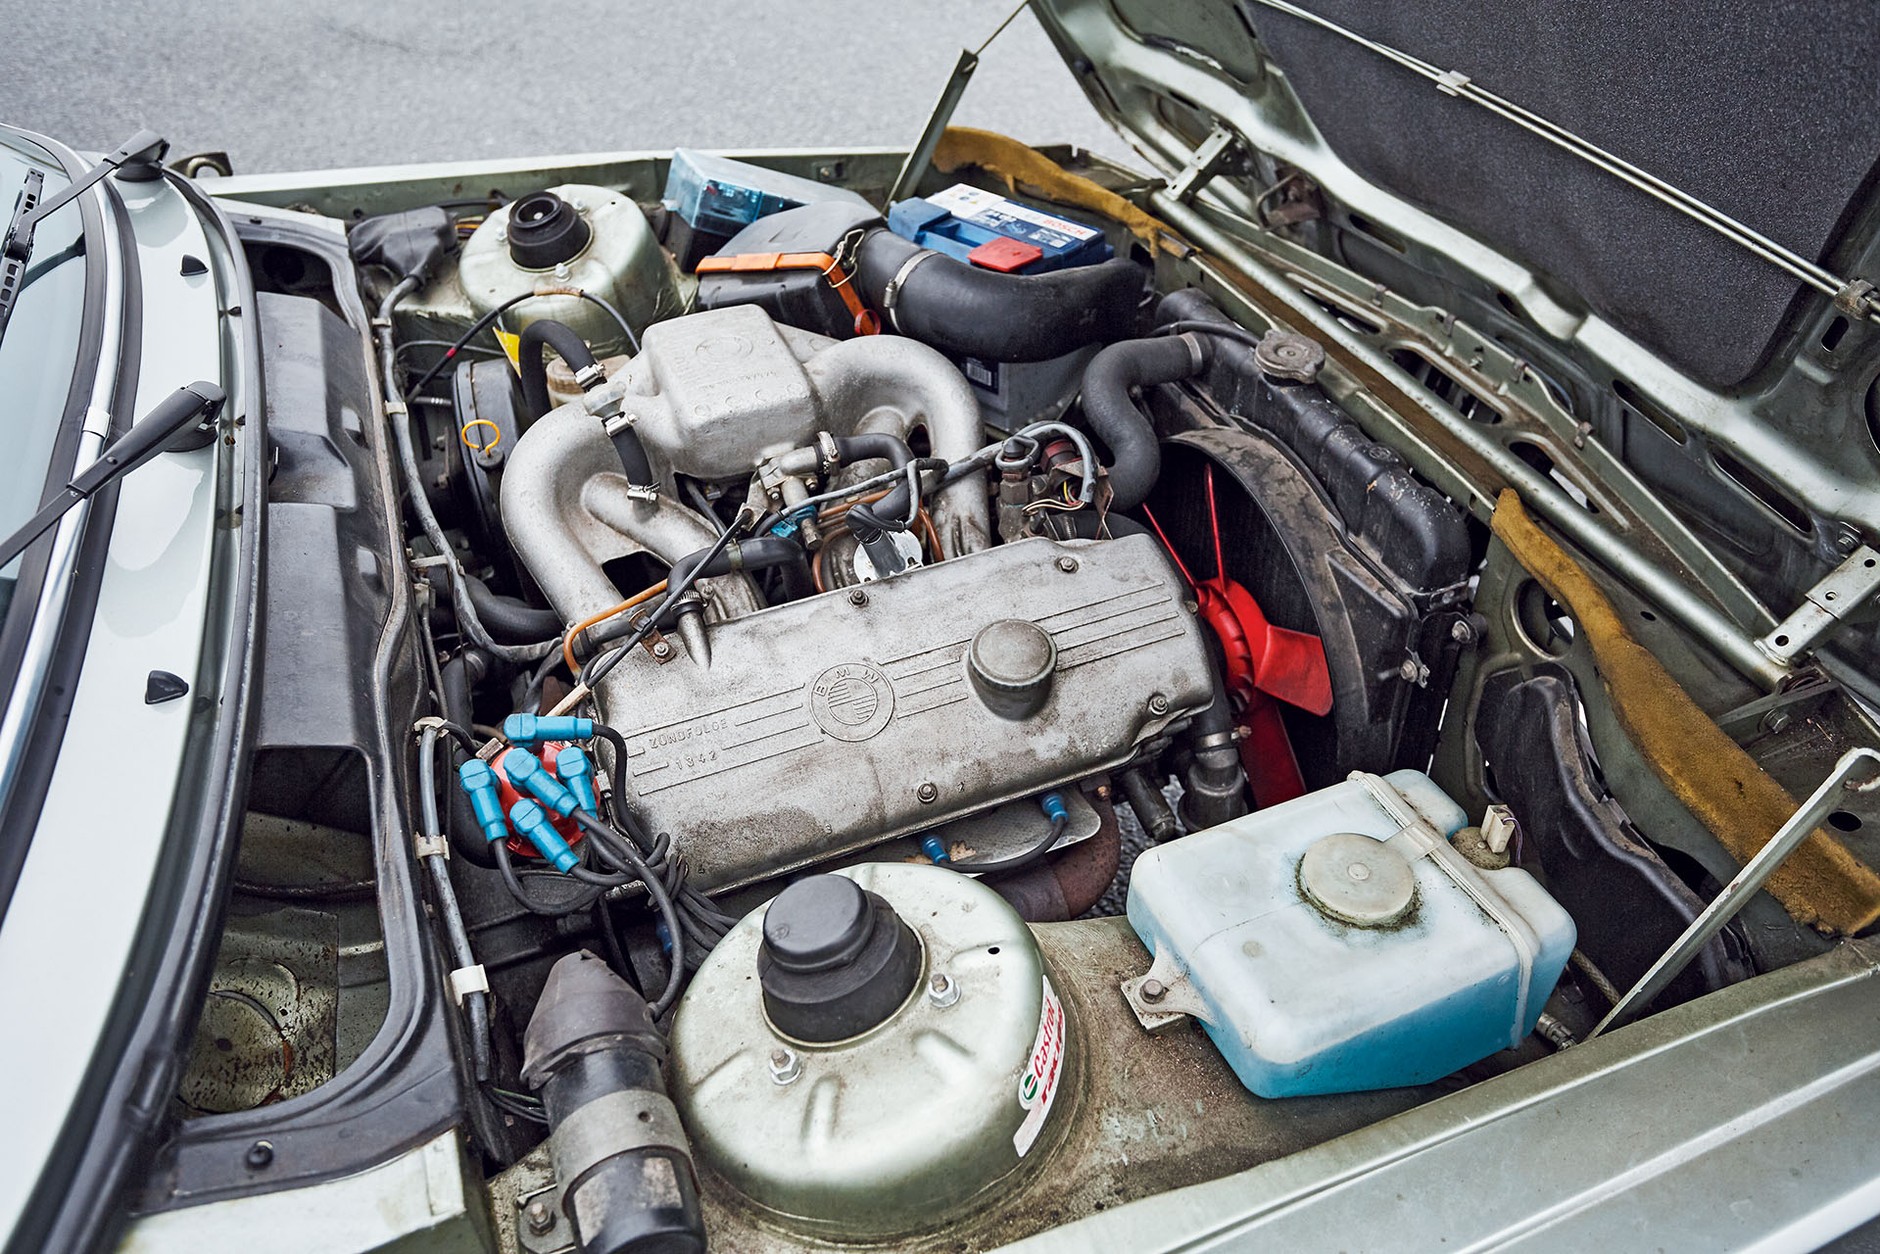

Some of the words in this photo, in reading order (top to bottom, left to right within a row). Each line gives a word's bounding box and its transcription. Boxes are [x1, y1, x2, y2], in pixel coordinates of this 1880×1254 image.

[1043, 219, 1087, 236] BOSCH
[814, 666, 880, 697] BMW
[1034, 995, 1055, 1079] Castrol
